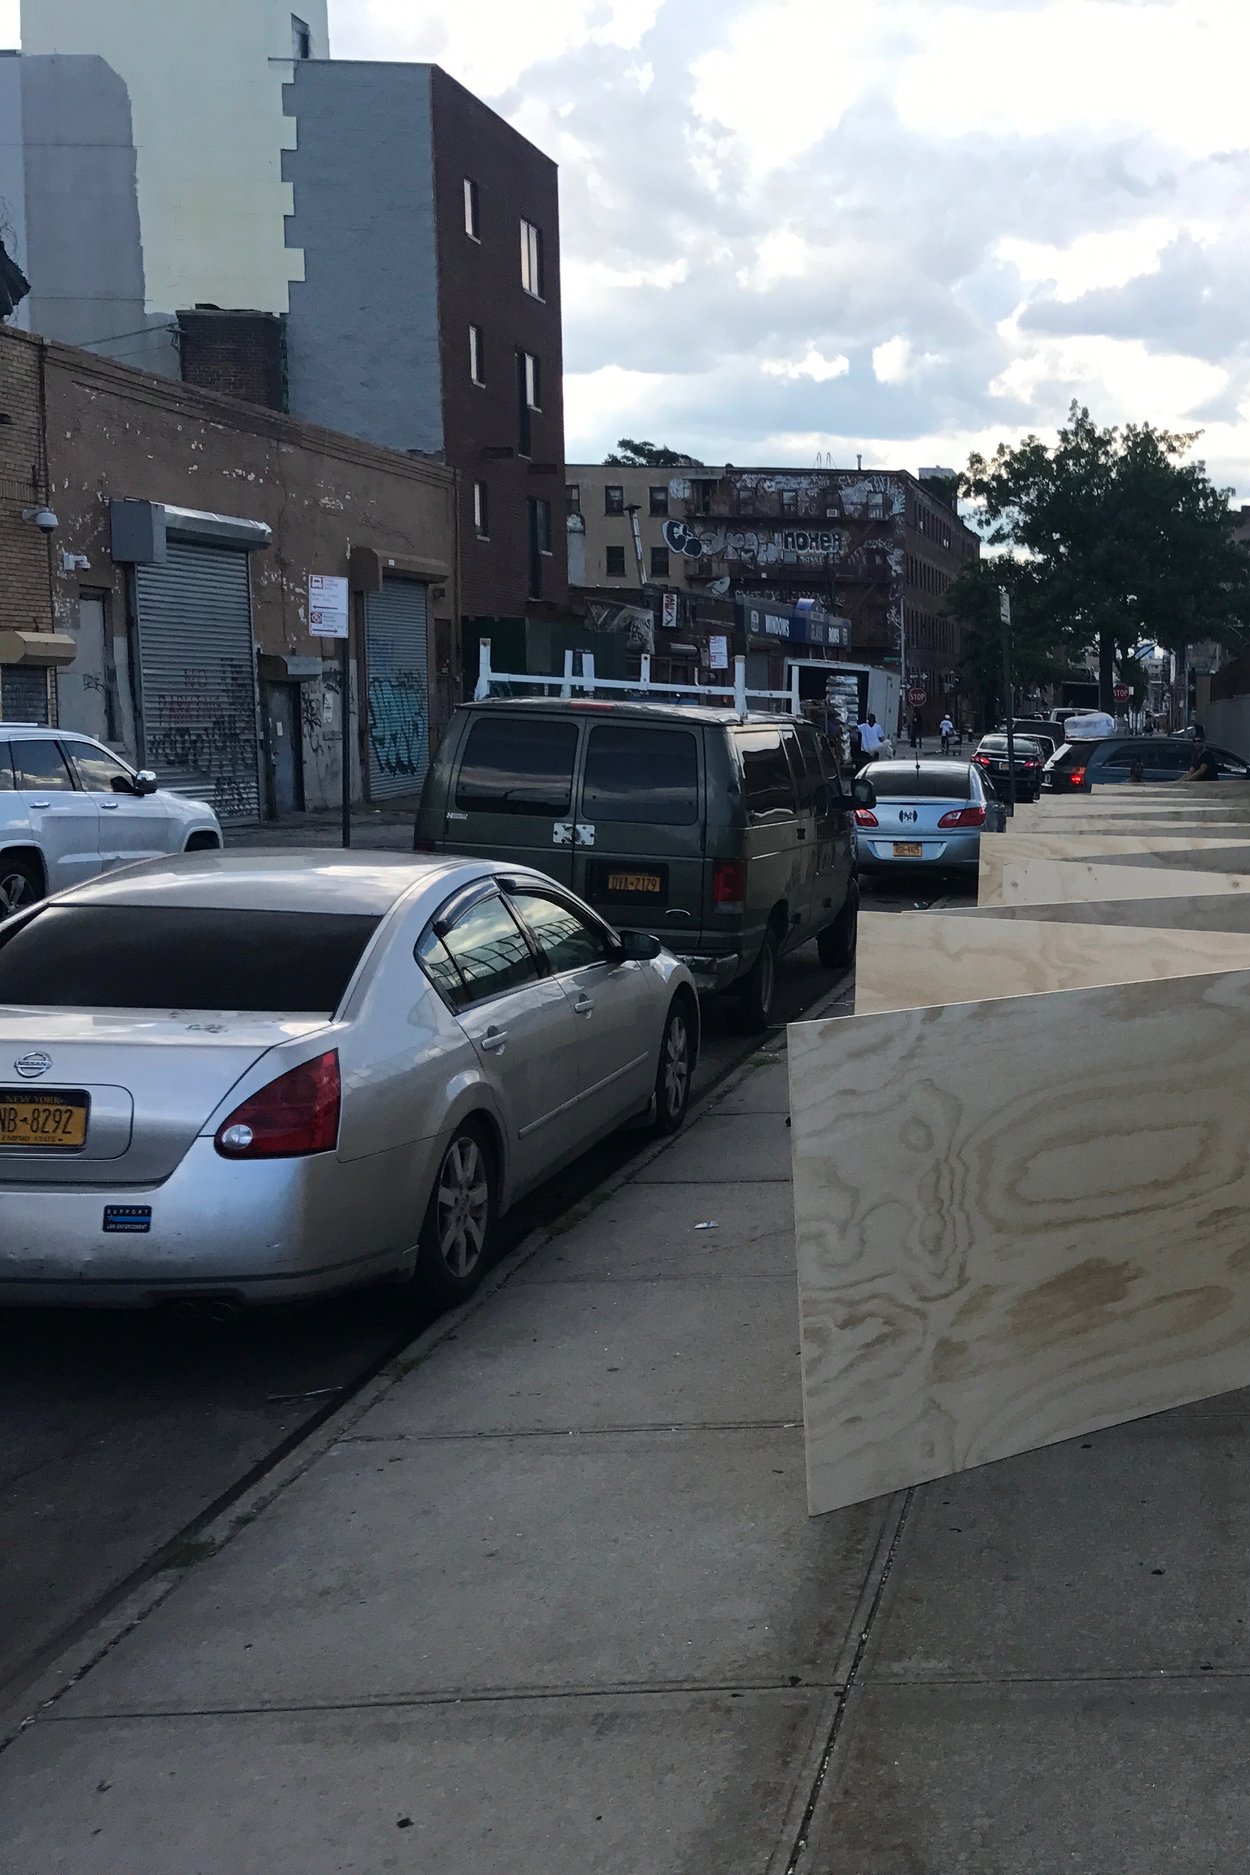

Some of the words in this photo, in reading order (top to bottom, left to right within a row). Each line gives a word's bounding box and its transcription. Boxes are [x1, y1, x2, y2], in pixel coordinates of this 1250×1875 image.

[909, 693, 926, 701] STOP
[1113, 689, 1129, 697] STOP
[6, 1095, 31, 1103] NEW
[34, 1095, 61, 1104] YORK
